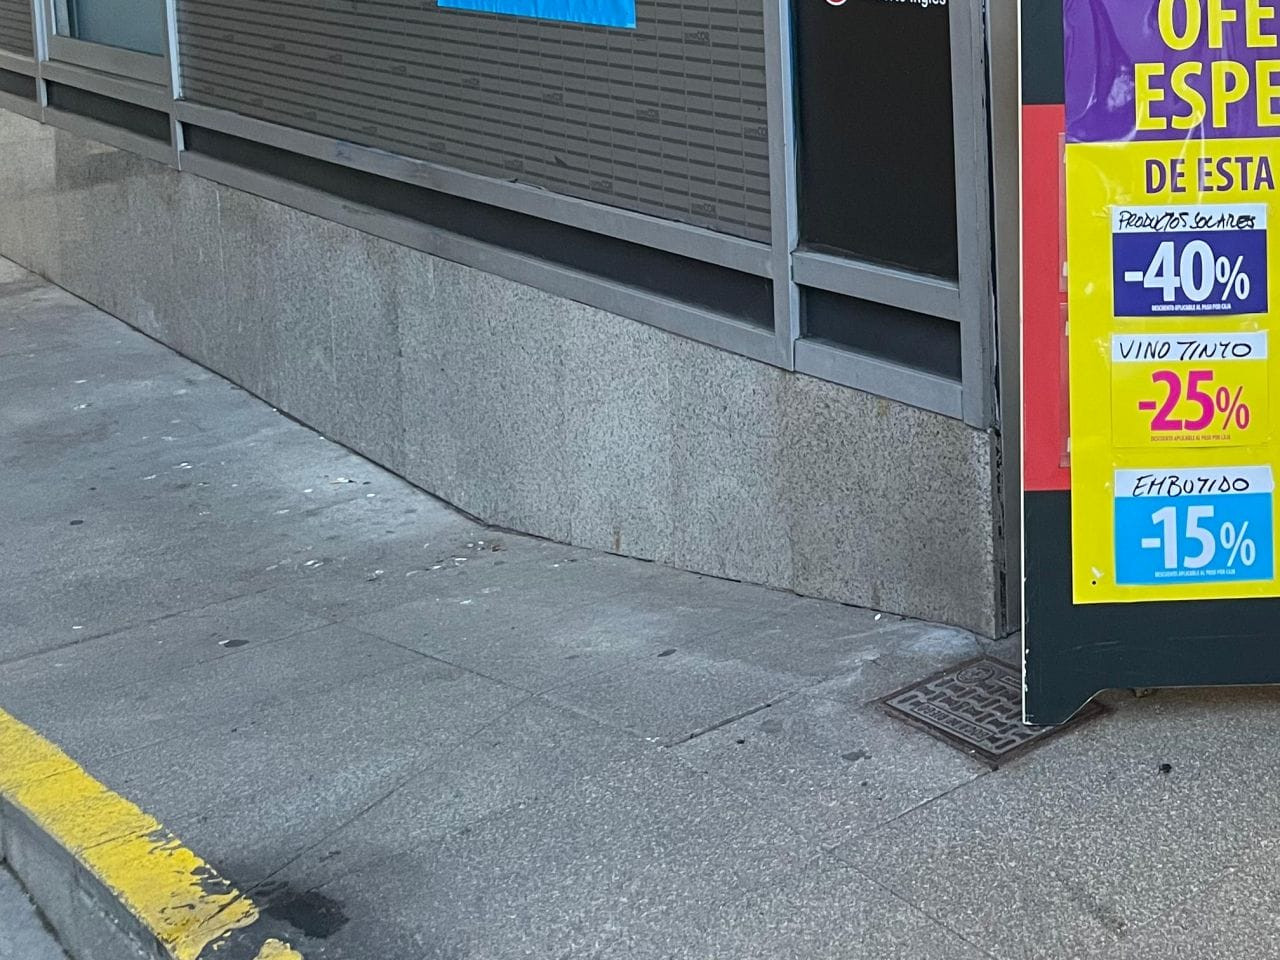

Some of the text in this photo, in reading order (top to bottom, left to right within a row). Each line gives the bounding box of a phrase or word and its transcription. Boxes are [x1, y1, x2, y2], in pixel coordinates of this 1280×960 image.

[1145, 158, 1186, 194] DE
[1197, 156, 1275, 193] ESTA
[1119, 210, 1188, 232] PRODUCTOS
[1124, 239, 1250, 302] -40%
[1119, 340, 1252, 361] VINO TINTO
[1138, 369, 1250, 431] -25%
[1132, 474, 1250, 497] EMBUTIDO
[1141, 505, 1256, 569] -15%
